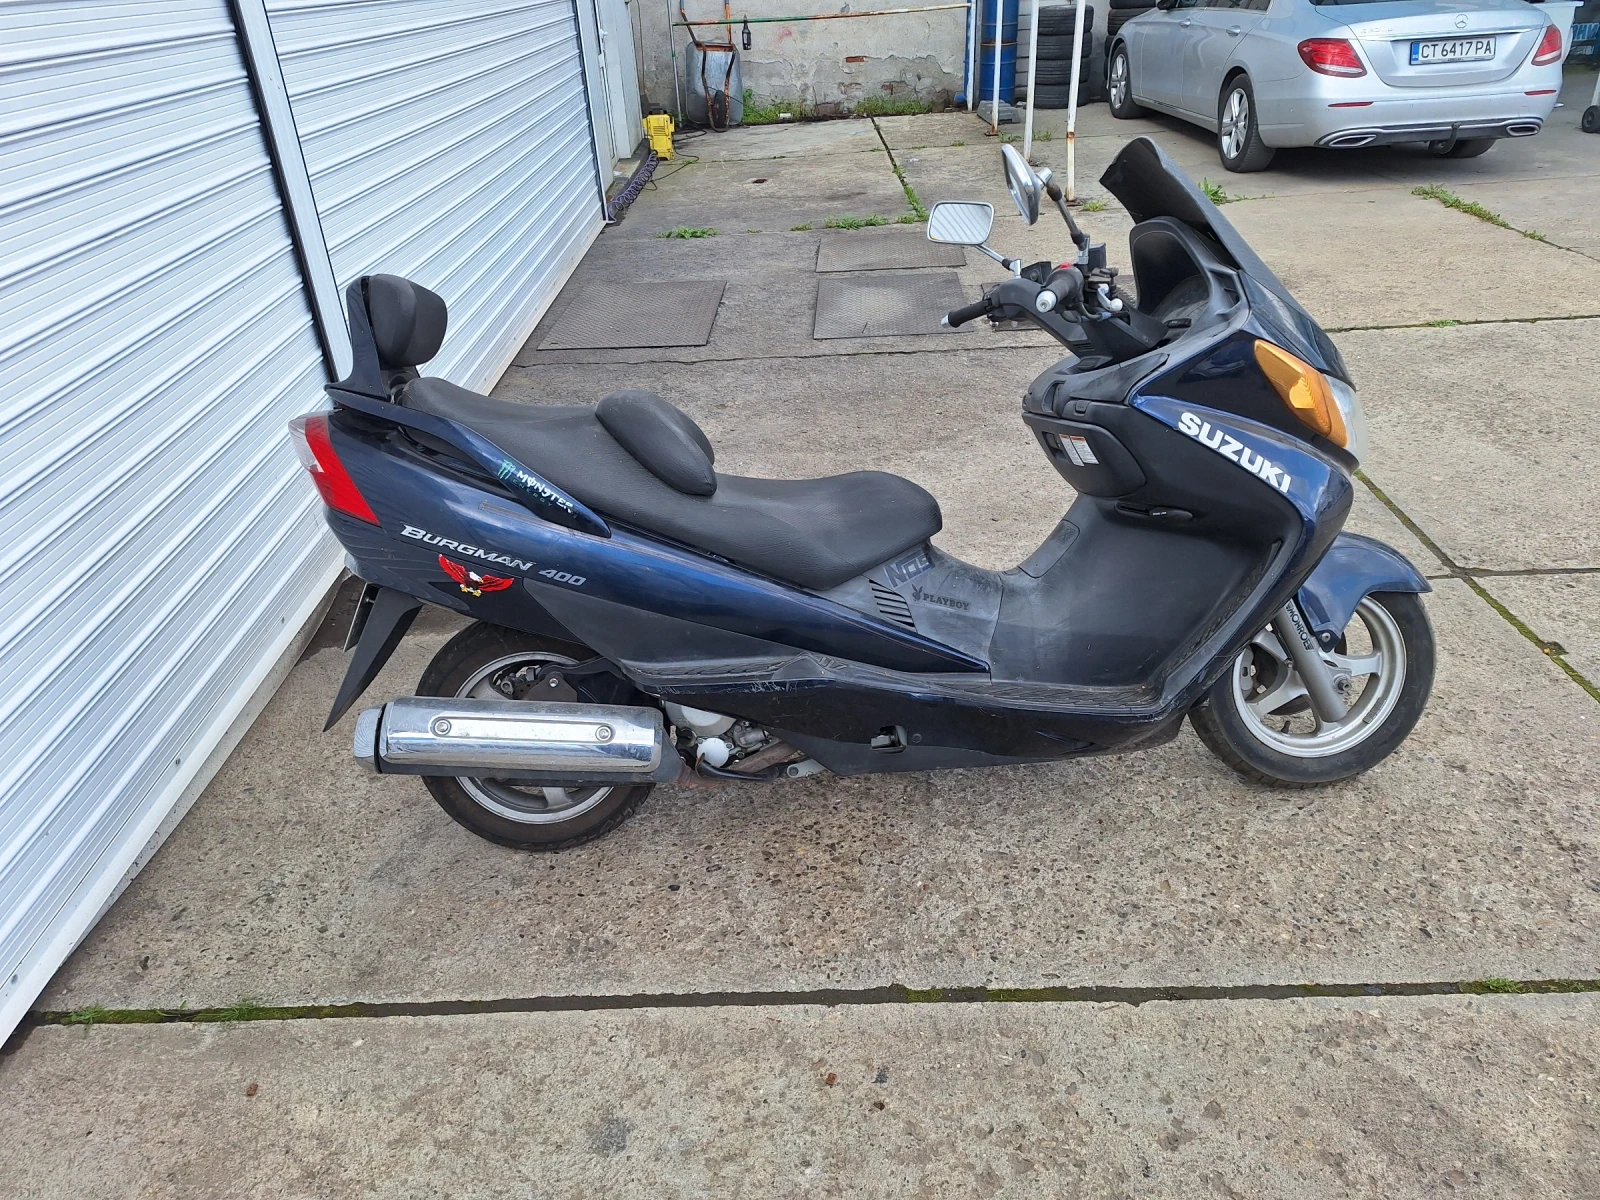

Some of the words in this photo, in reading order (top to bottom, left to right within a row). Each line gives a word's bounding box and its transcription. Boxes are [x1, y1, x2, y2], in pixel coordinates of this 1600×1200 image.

[1178, 412, 1291, 493] SUZUKI
[538, 568, 587, 586] 400
[922, 592, 970, 611] PLAYBOY
[1286, 603, 1312, 650] MONROE
